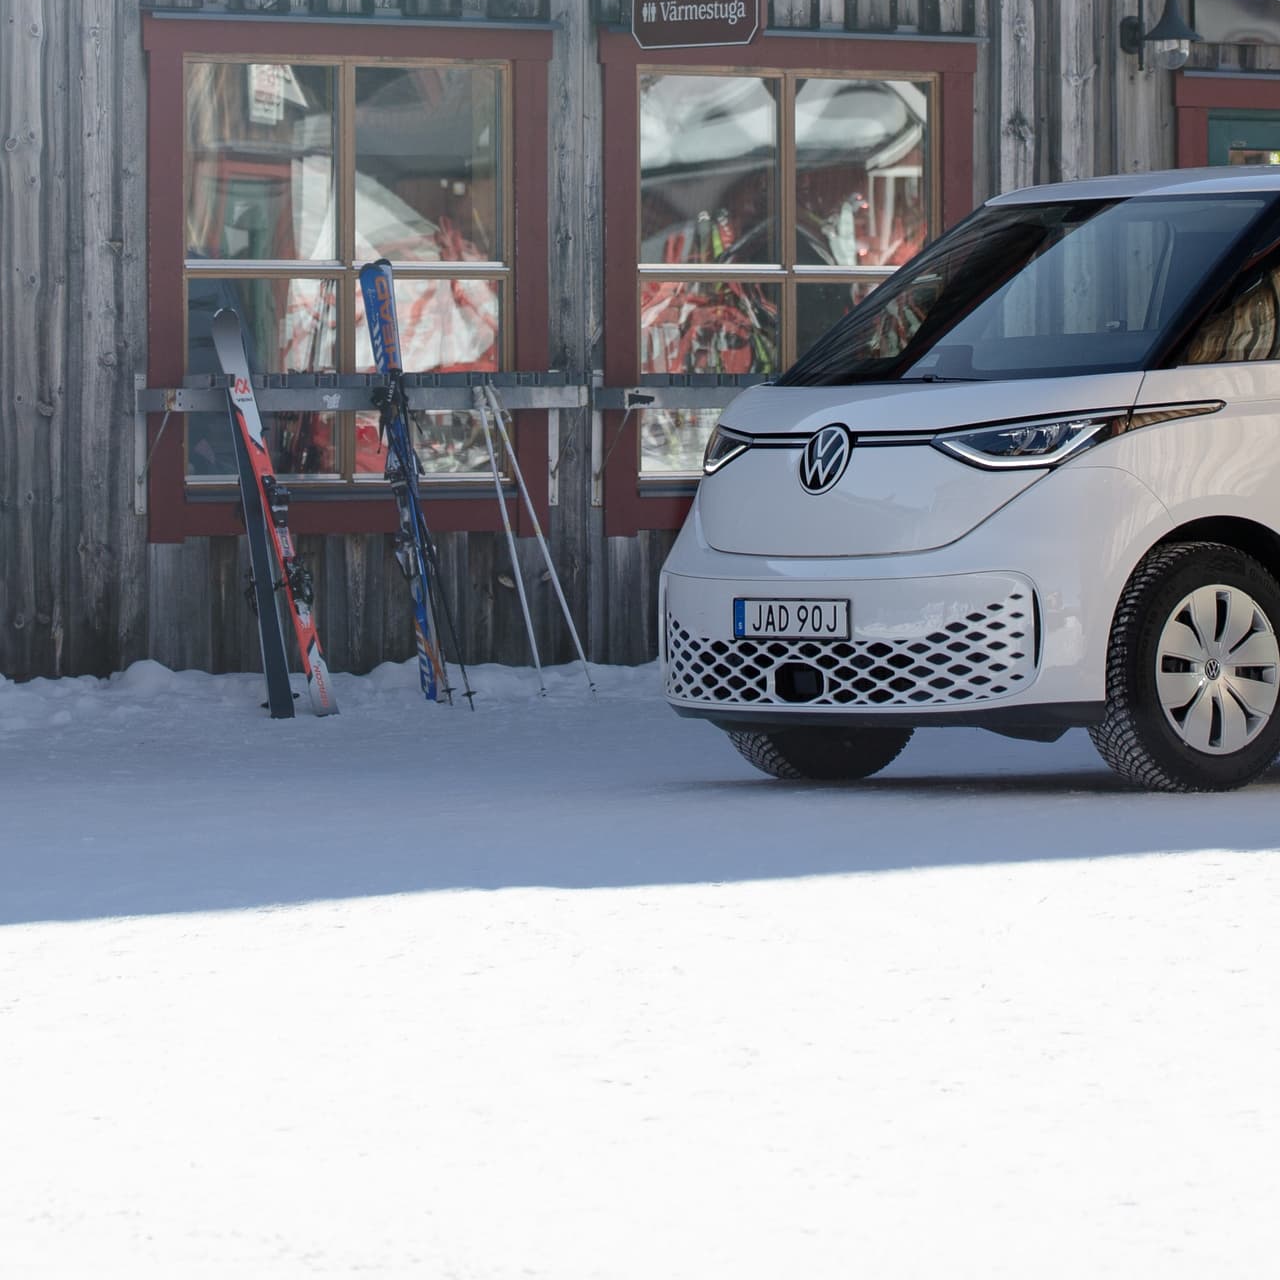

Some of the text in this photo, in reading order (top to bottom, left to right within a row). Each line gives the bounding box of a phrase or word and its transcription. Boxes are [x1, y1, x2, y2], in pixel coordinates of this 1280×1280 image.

[660, 0, 746, 25] Värmestuga
[375, 275, 398, 369] HEAD
[752, 604, 837, 632] JAD 90J
